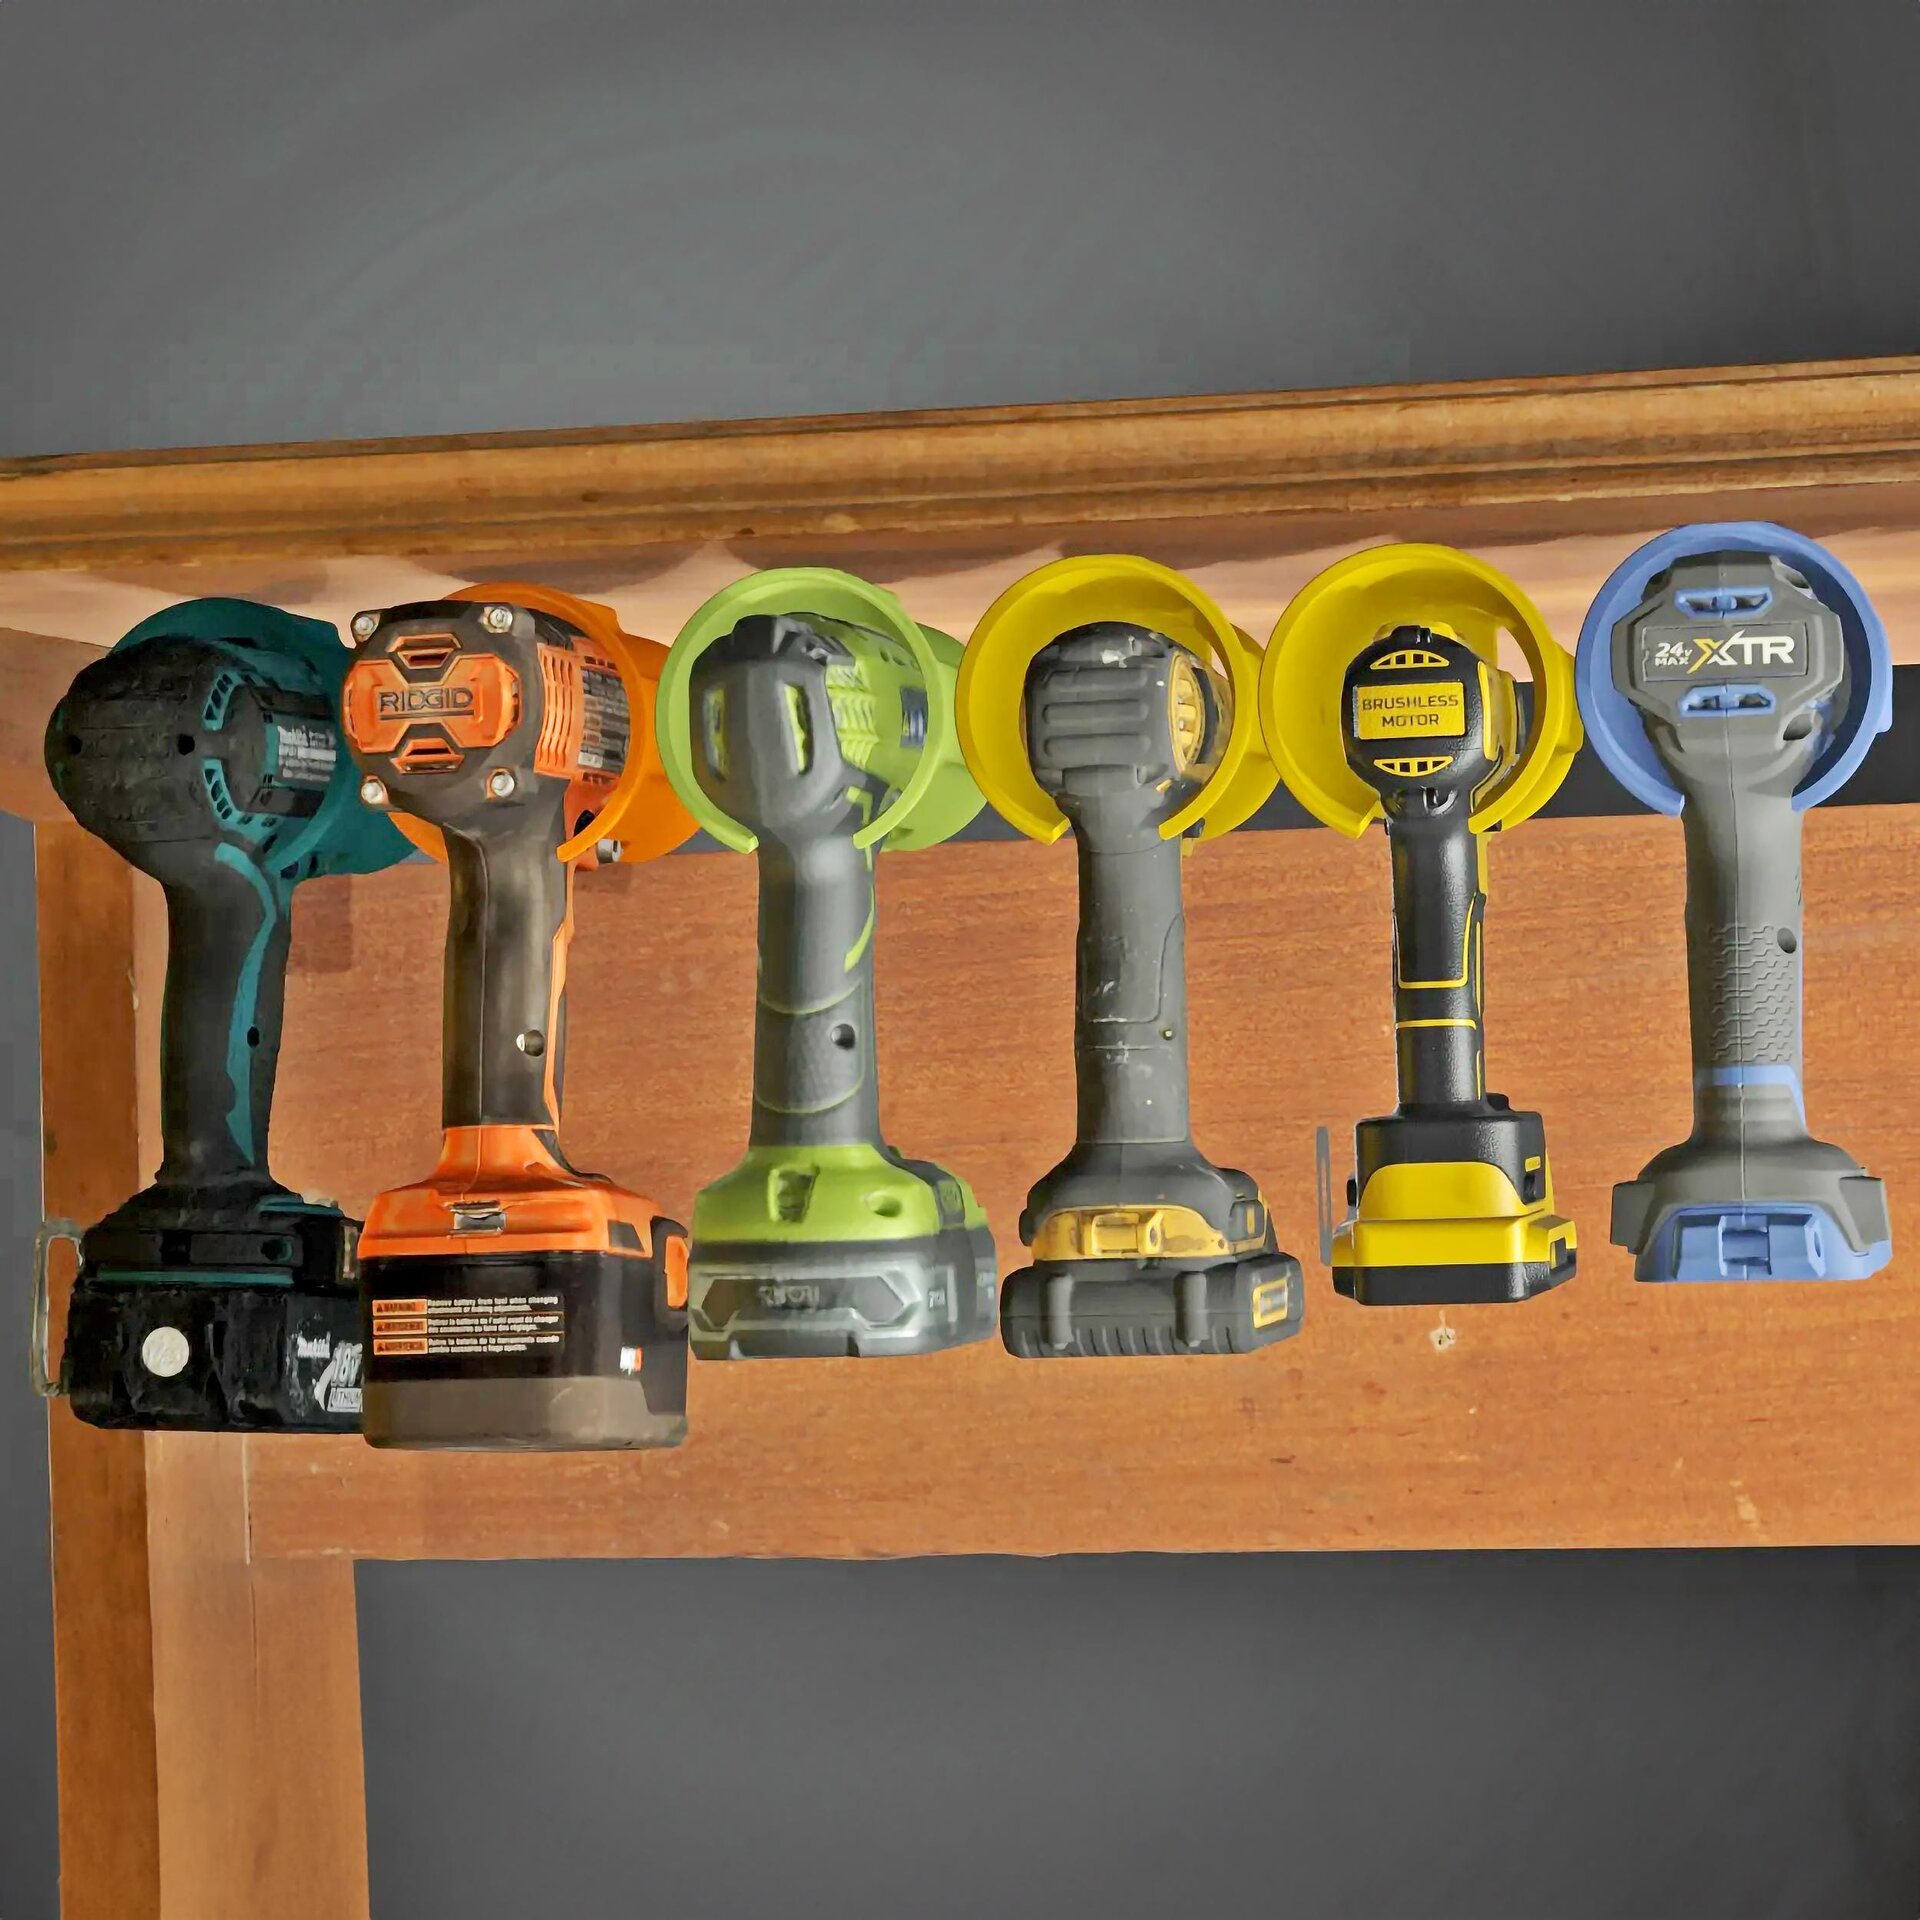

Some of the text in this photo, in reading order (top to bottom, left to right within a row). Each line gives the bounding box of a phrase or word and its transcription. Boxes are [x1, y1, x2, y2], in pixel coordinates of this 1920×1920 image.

[1686, 629, 1795, 674] XTR
[1654, 656, 1691, 667] MAX
[379, 687, 474, 713] RIDGID
[1362, 695, 1459, 711] BRUSHLESS
[1381, 713, 1440, 728] MOTOR
